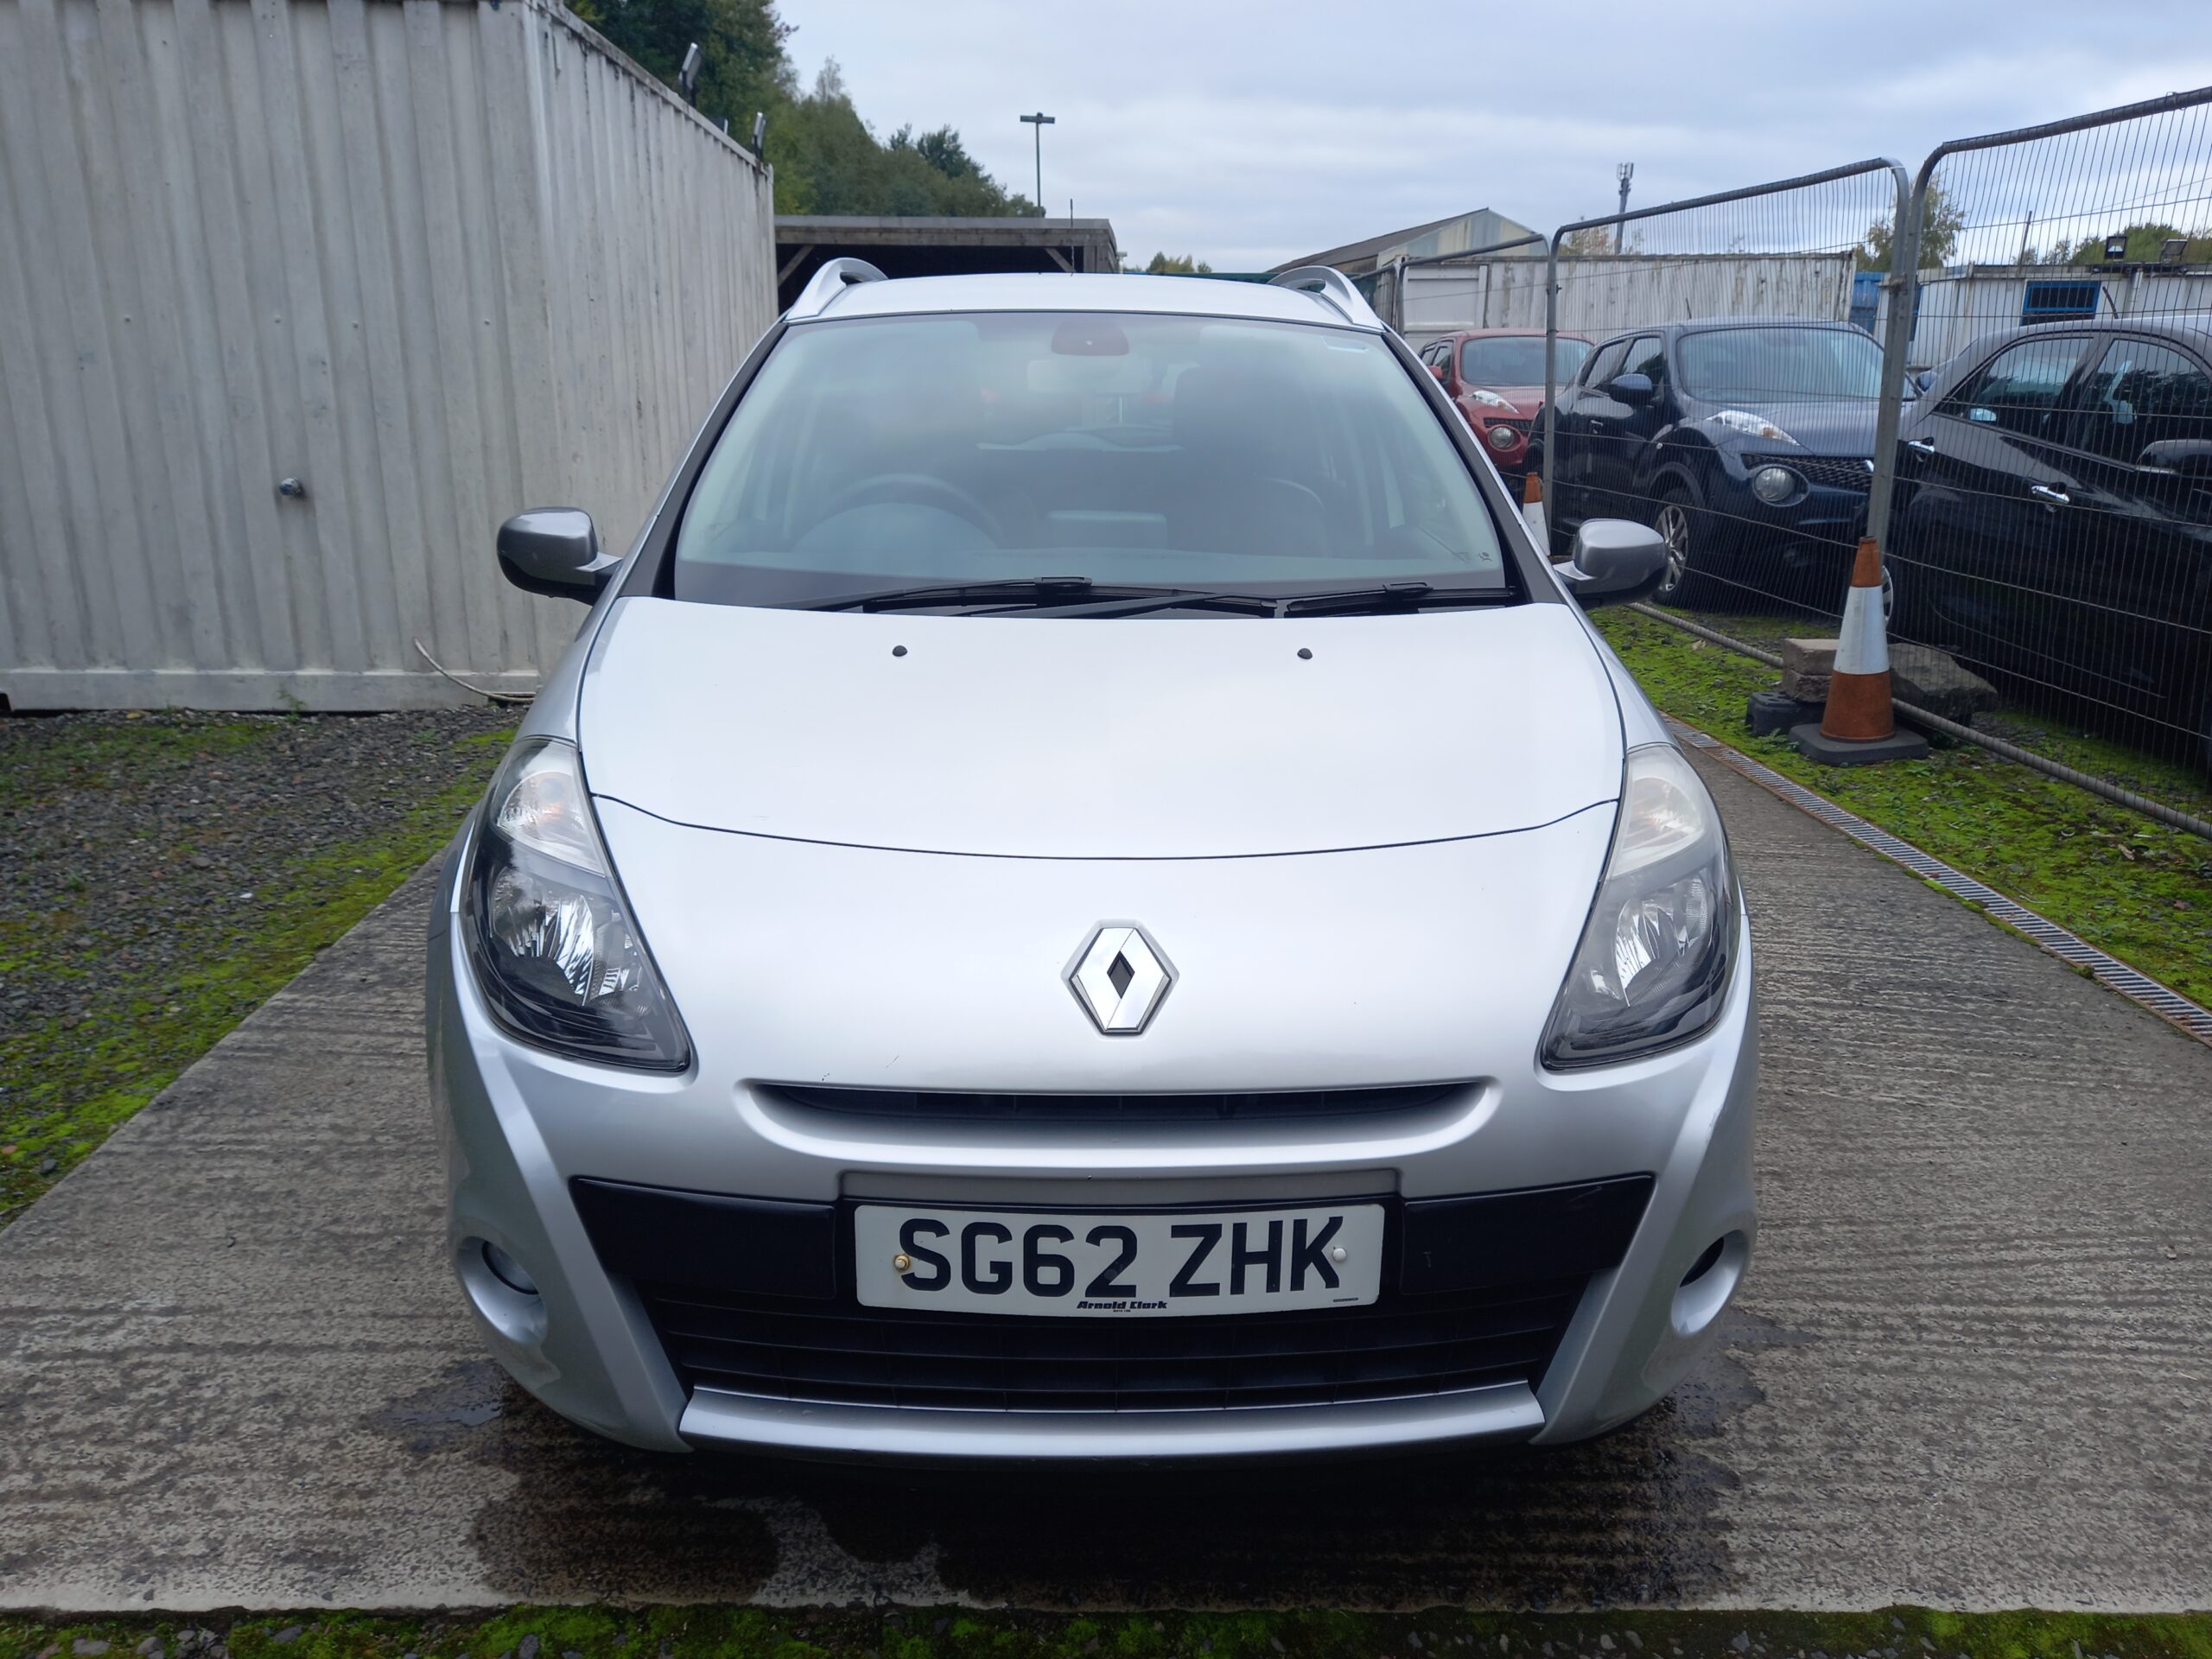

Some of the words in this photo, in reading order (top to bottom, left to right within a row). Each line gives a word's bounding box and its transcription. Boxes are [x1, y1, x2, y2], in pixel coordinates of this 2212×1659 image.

[899, 1218, 1138, 1298] SG62
[1169, 1216, 1344, 1298] ZHK
[1077, 1300, 1127, 1309] Arnold
[1129, 1300, 1167, 1309] Clark
